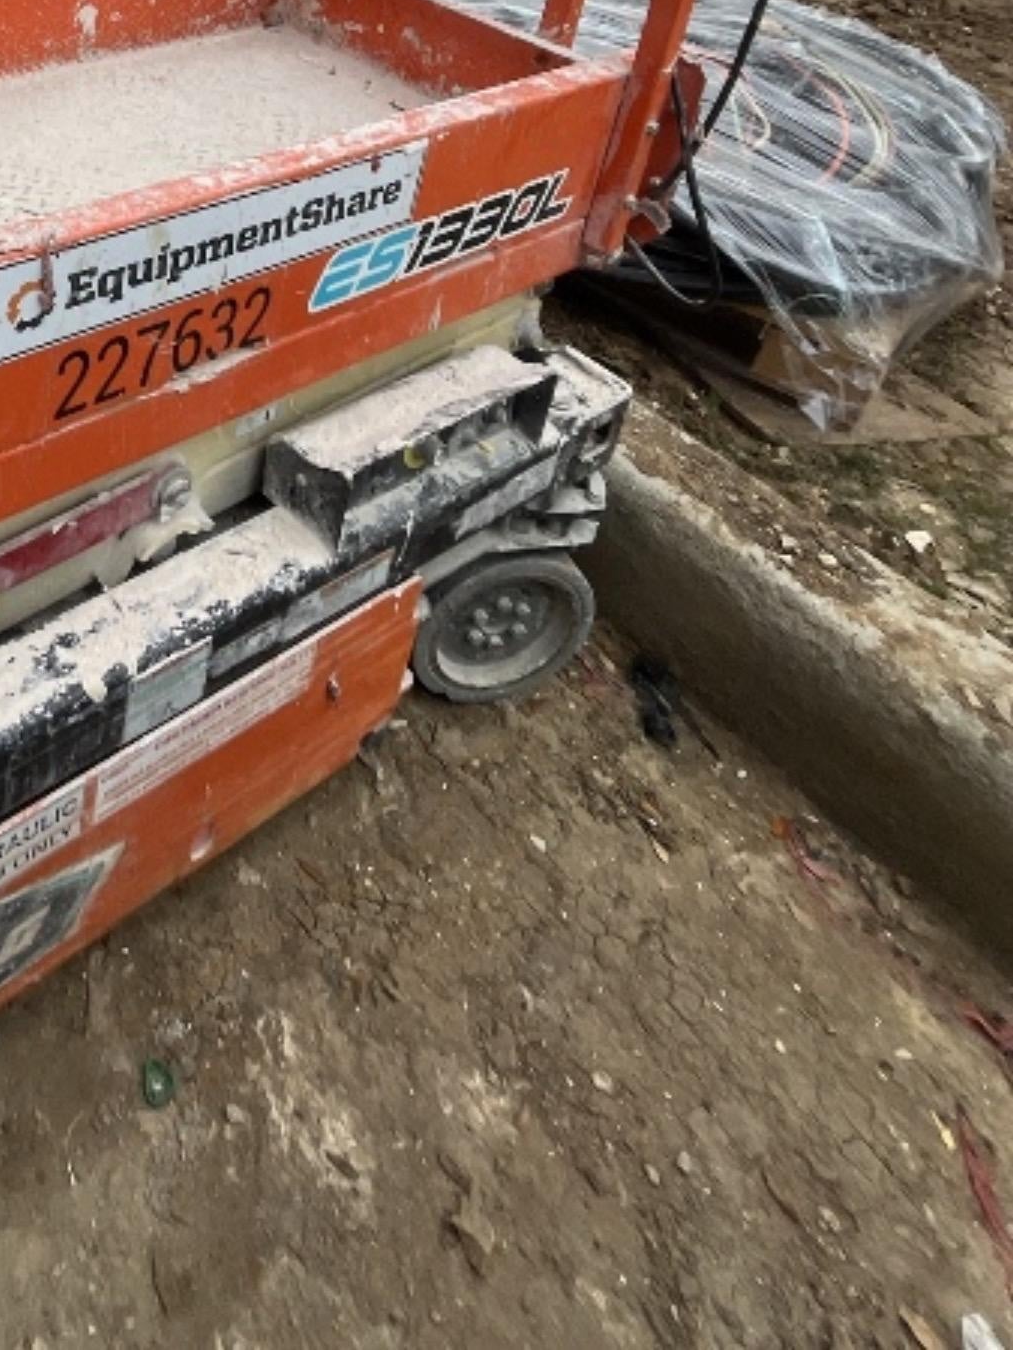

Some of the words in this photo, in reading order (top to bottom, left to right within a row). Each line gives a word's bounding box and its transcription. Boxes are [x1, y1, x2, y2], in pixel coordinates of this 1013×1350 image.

[64, 177, 402, 310] EquipmentShare
[310, 171, 570, 311] ES1330L
[53, 286, 272, 421] 227632
